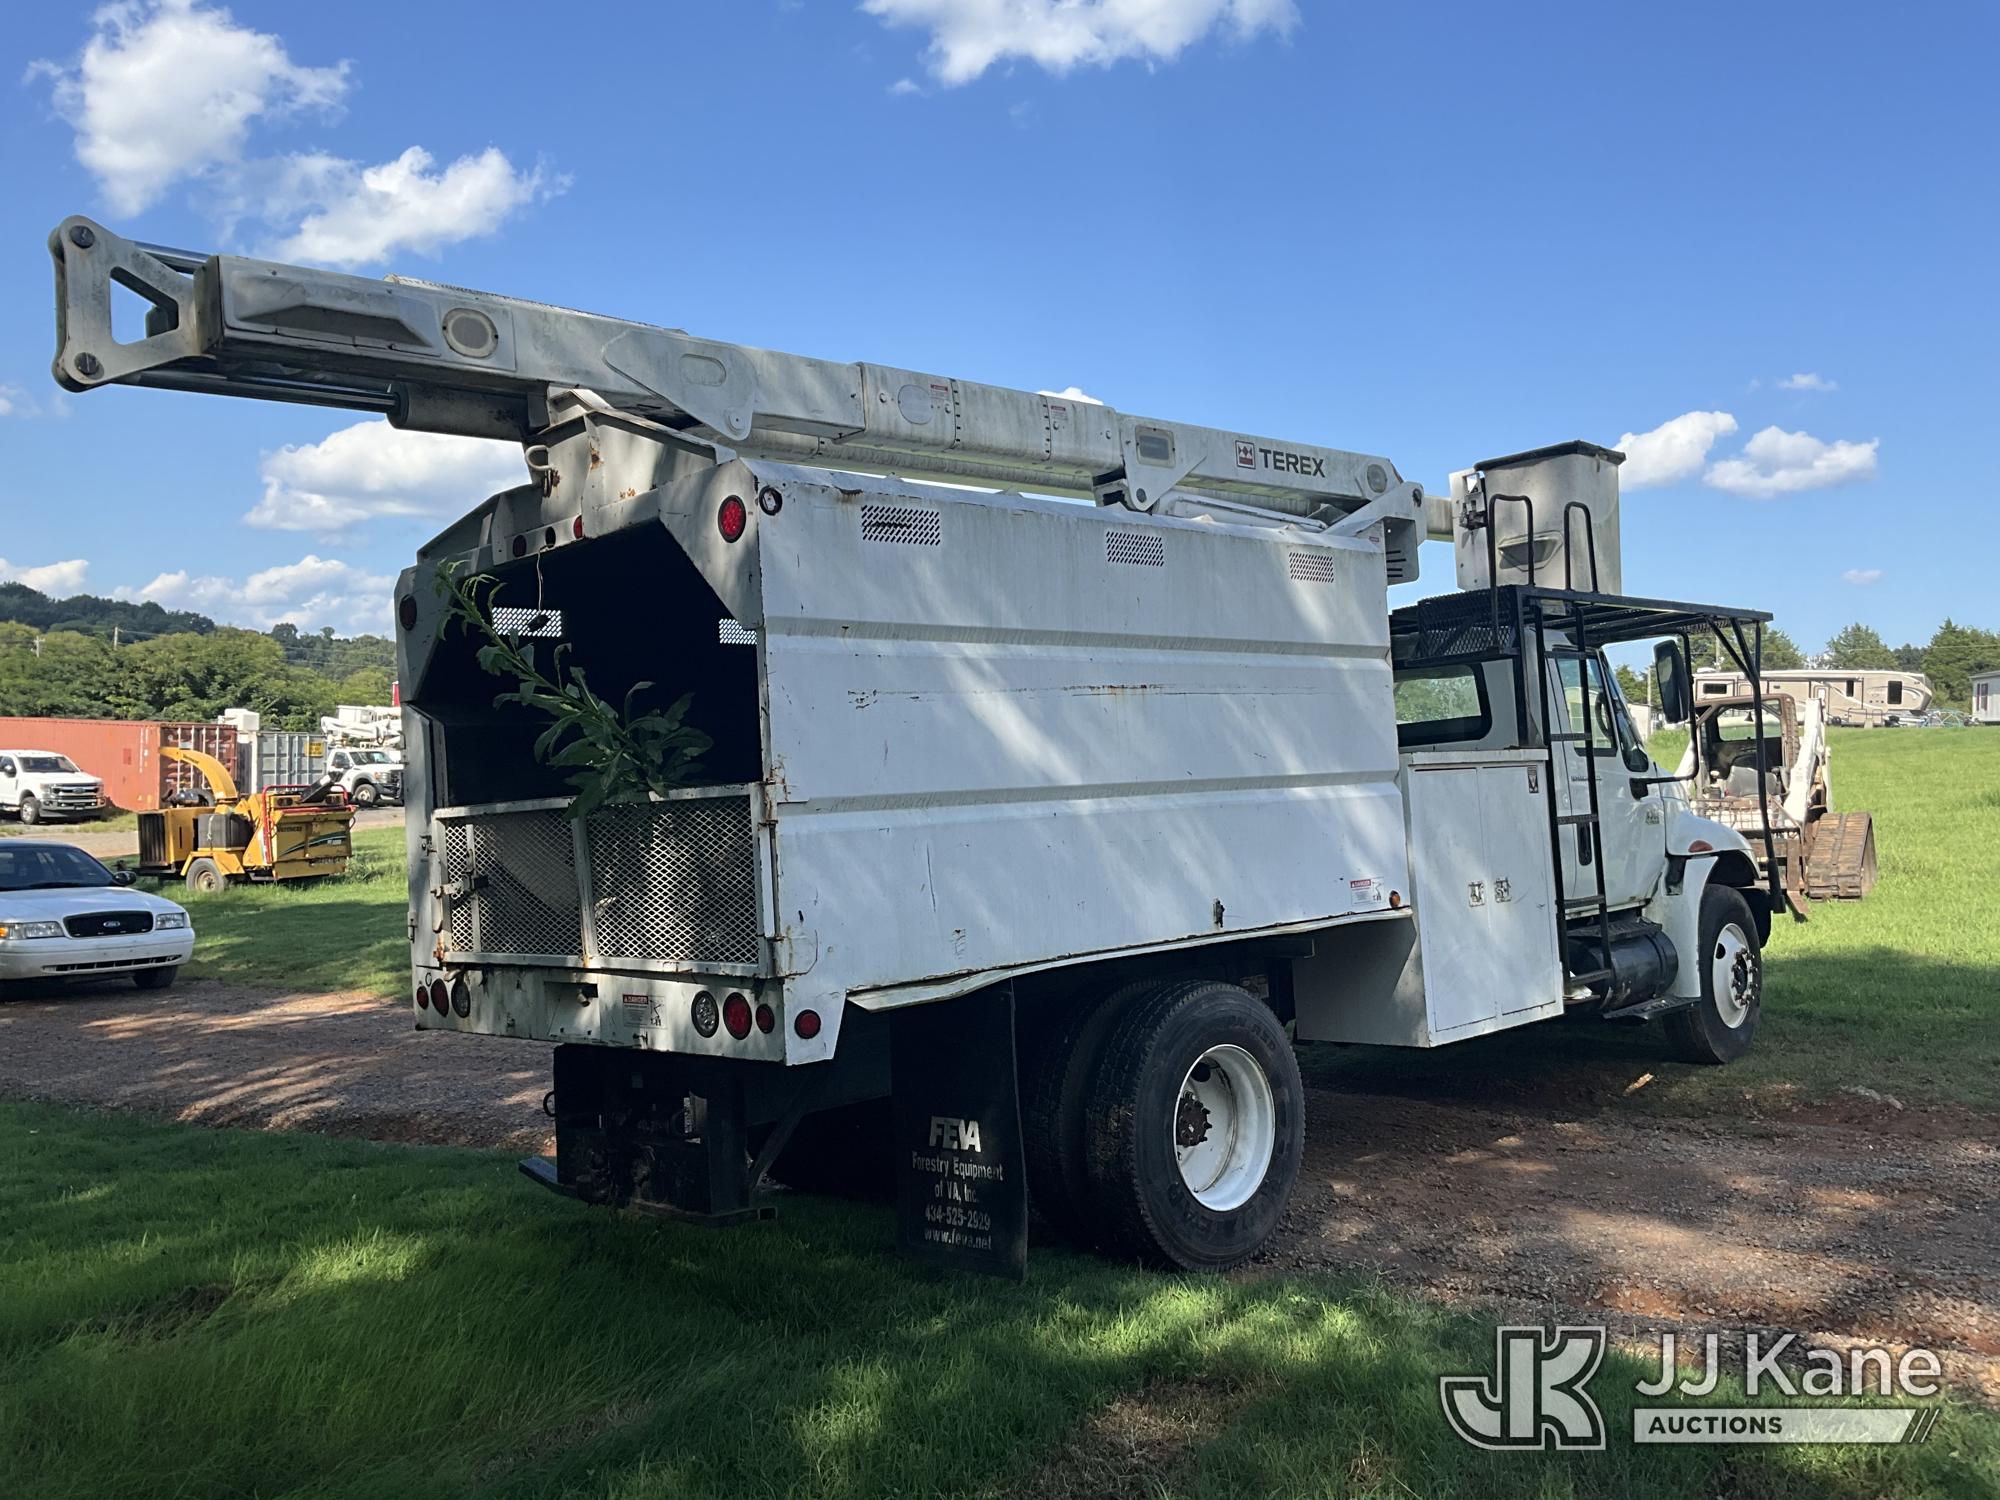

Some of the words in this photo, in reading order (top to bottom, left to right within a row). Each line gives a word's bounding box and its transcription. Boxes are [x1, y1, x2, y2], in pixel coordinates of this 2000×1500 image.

[1259, 447, 1326, 479] TEREX
[929, 1115, 982, 1153] FEVA
[912, 1151, 950, 1178] Forestry
[952, 1155, 1004, 1182] Equipment
[934, 1179, 944, 1198] of
[947, 1181, 962, 1205] VA,
[924, 1228, 992, 1251] www.feva.net
